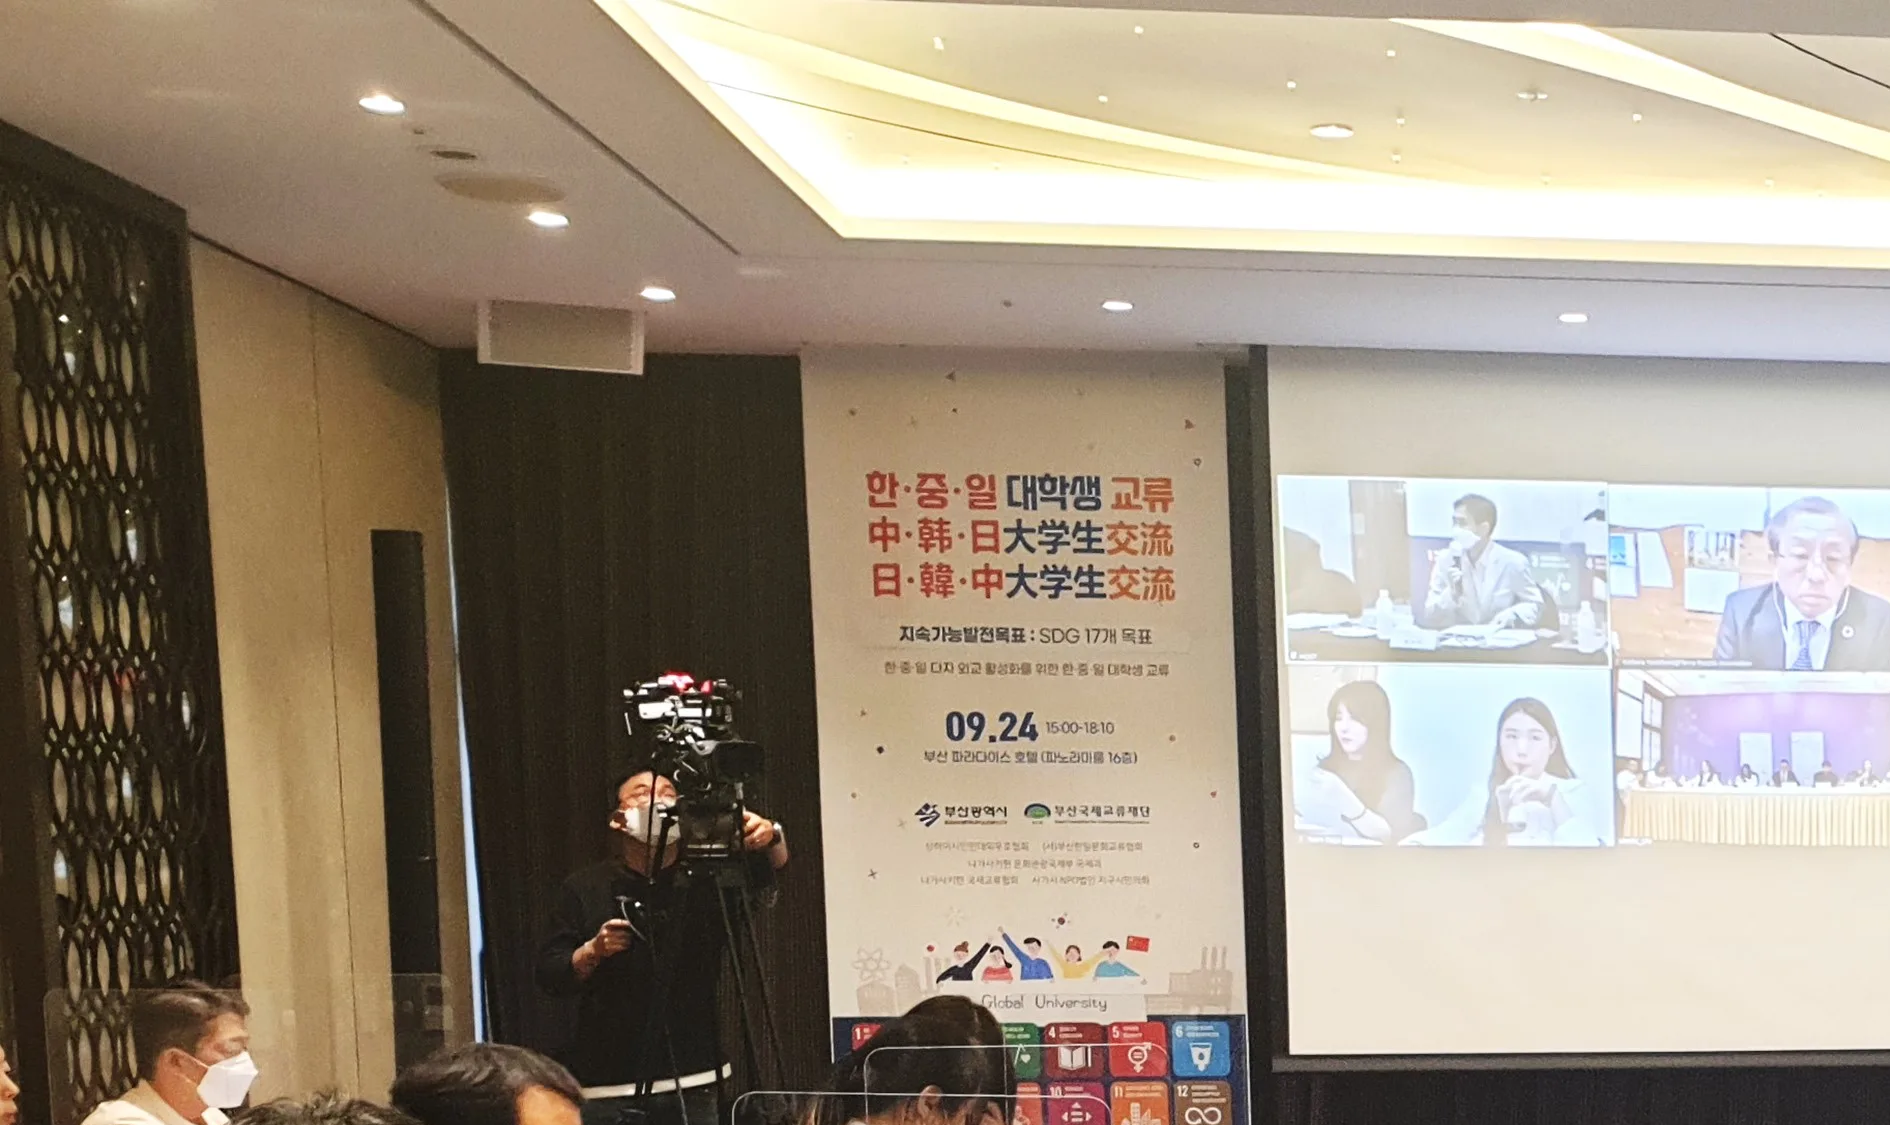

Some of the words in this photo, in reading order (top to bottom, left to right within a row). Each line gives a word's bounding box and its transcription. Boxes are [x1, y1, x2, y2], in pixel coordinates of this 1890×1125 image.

[866, 470, 998, 511] 한·중·일
[1006, 473, 1102, 511] 대학생
[1111, 476, 1175, 512] 교류
[899, 626, 1027, 644] 지속가능발전목표
[1039, 628, 1081, 644] SDG
[1084, 628, 1117, 645] 17개
[1121, 628, 1153, 645] 목표
[930, 661, 955, 674] 다자
[957, 662, 982, 675] 외교
[1035, 663, 1059, 676] 위한
[1107, 663, 1143, 677] 대학생
[1146, 664, 1170, 677] 교류
[945, 710, 1040, 743] 09.24
[924, 750, 948, 764] 부산
[952, 750, 1012, 764] 파라다이스
[1014, 750, 1038, 764] 호텔
[944, 805, 1008, 819] 부산광역시
[1054, 805, 1151, 818] 부산국제교류재단
[981, 994, 1024, 1010] Global
[1034, 994, 1108, 1013] University
[854, 1028, 861, 1040] 1
[1048, 1026, 1056, 1039] 4
[1112, 1026, 1120, 1039] 5
[1174, 1026, 1183, 1039] 6
[1113, 1086, 1124, 1098] 11
[1177, 1085, 1189, 1097] 12
